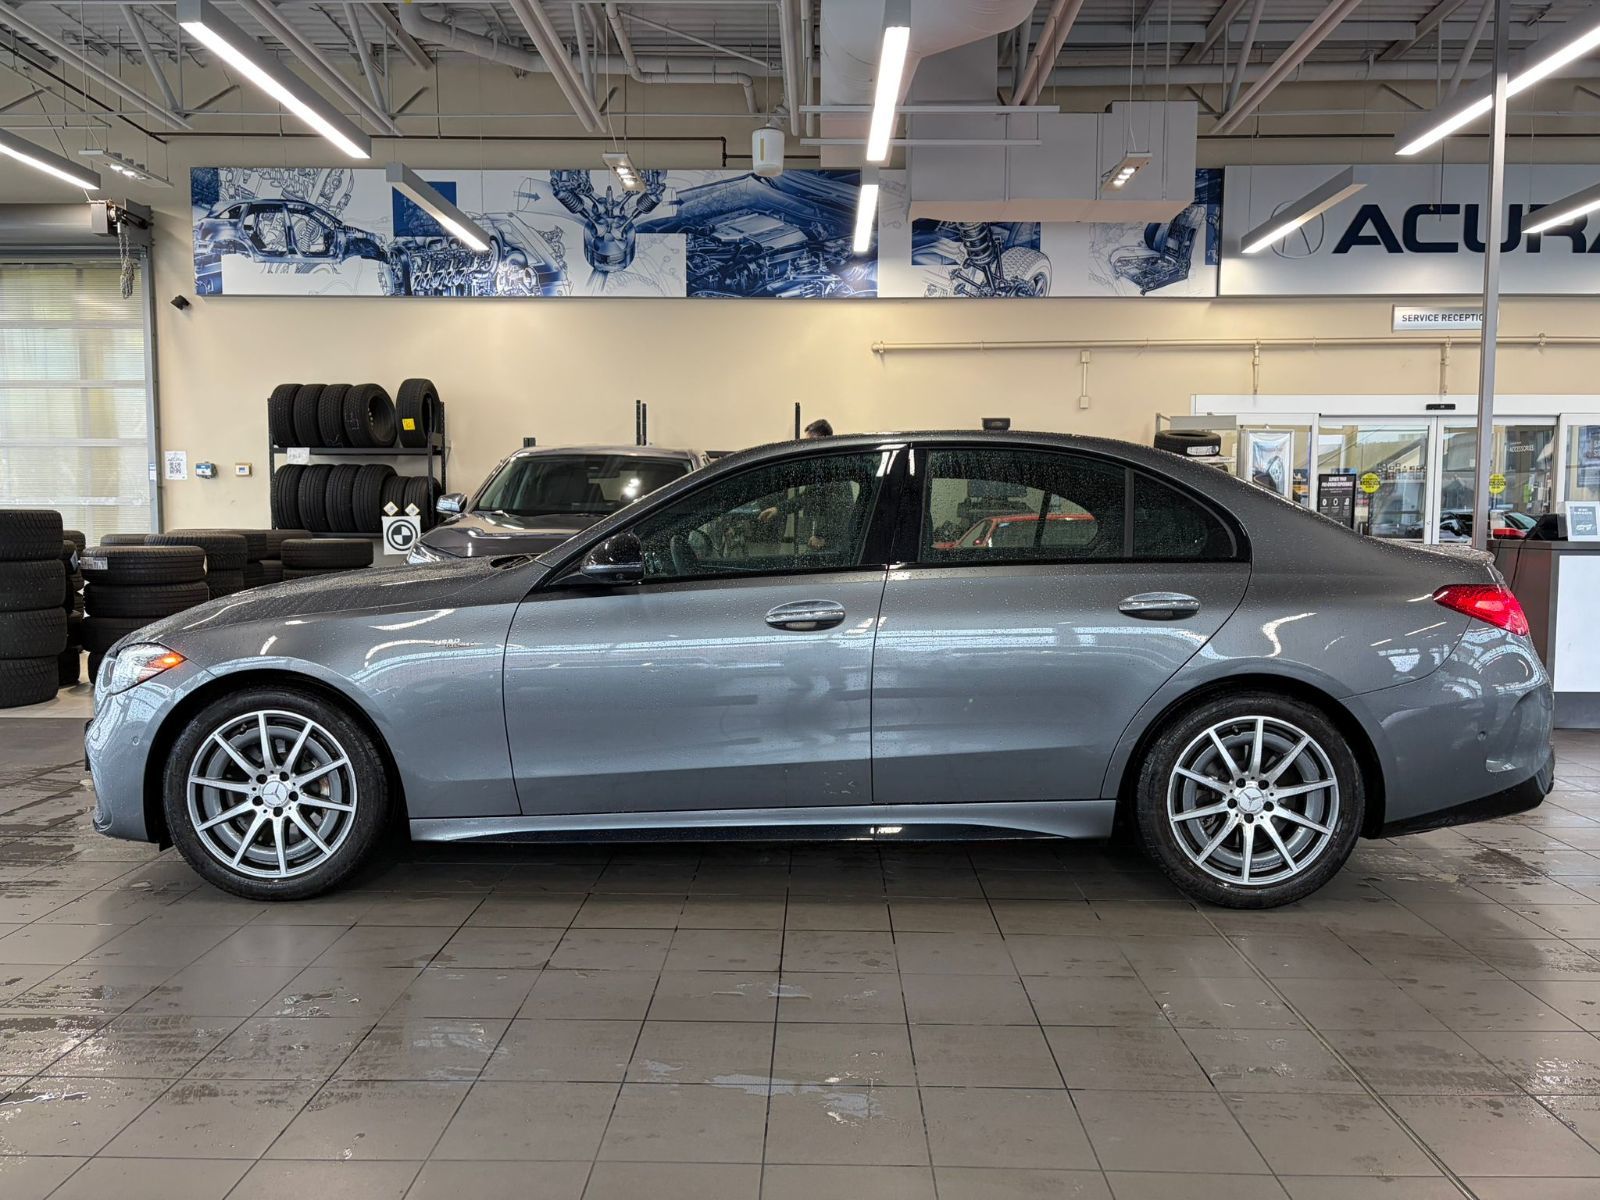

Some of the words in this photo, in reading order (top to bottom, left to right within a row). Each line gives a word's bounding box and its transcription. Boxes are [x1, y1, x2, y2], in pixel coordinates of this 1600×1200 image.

[1332, 203, 1600, 254] ACUR
[1401, 313, 1439, 323] SERVICE
[1441, 312, 1483, 322] RECEPTIO
